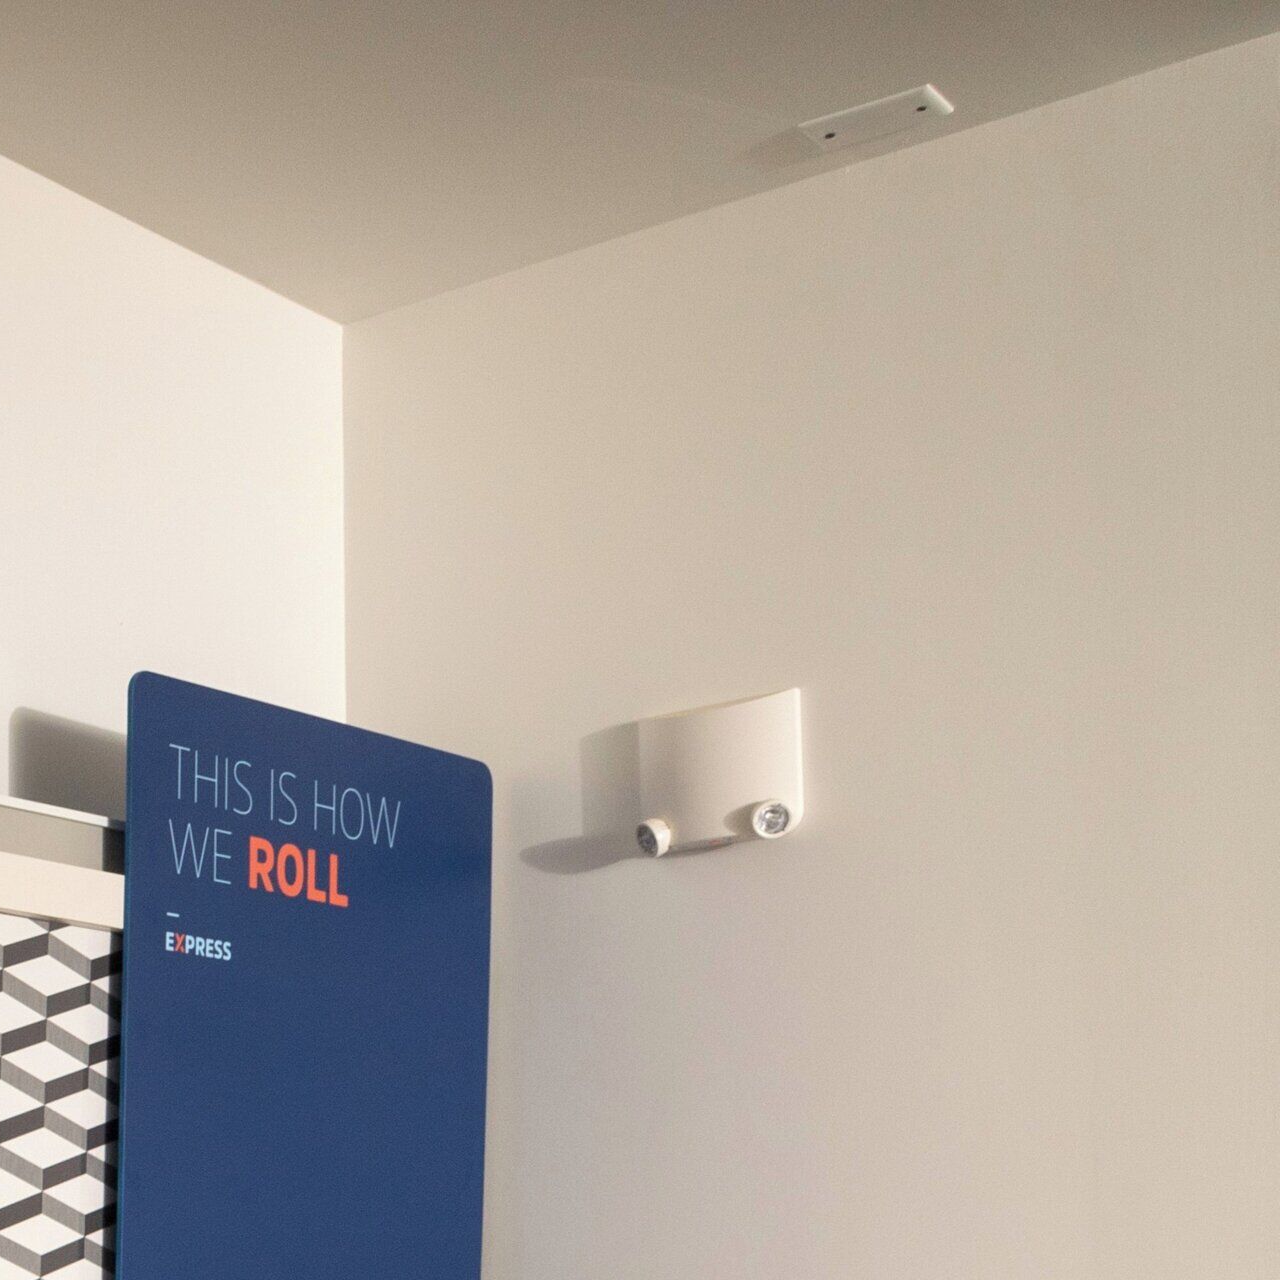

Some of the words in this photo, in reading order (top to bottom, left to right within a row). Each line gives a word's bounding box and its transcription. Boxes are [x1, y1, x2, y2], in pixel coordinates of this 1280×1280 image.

[169, 743, 253, 815] THIS
[270, 769, 298, 826] IS
[314, 780, 401, 848] HOW
[169, 818, 232, 885] WE
[248, 835, 349, 908] ROLL
[165, 931, 232, 961] EXPRESS
